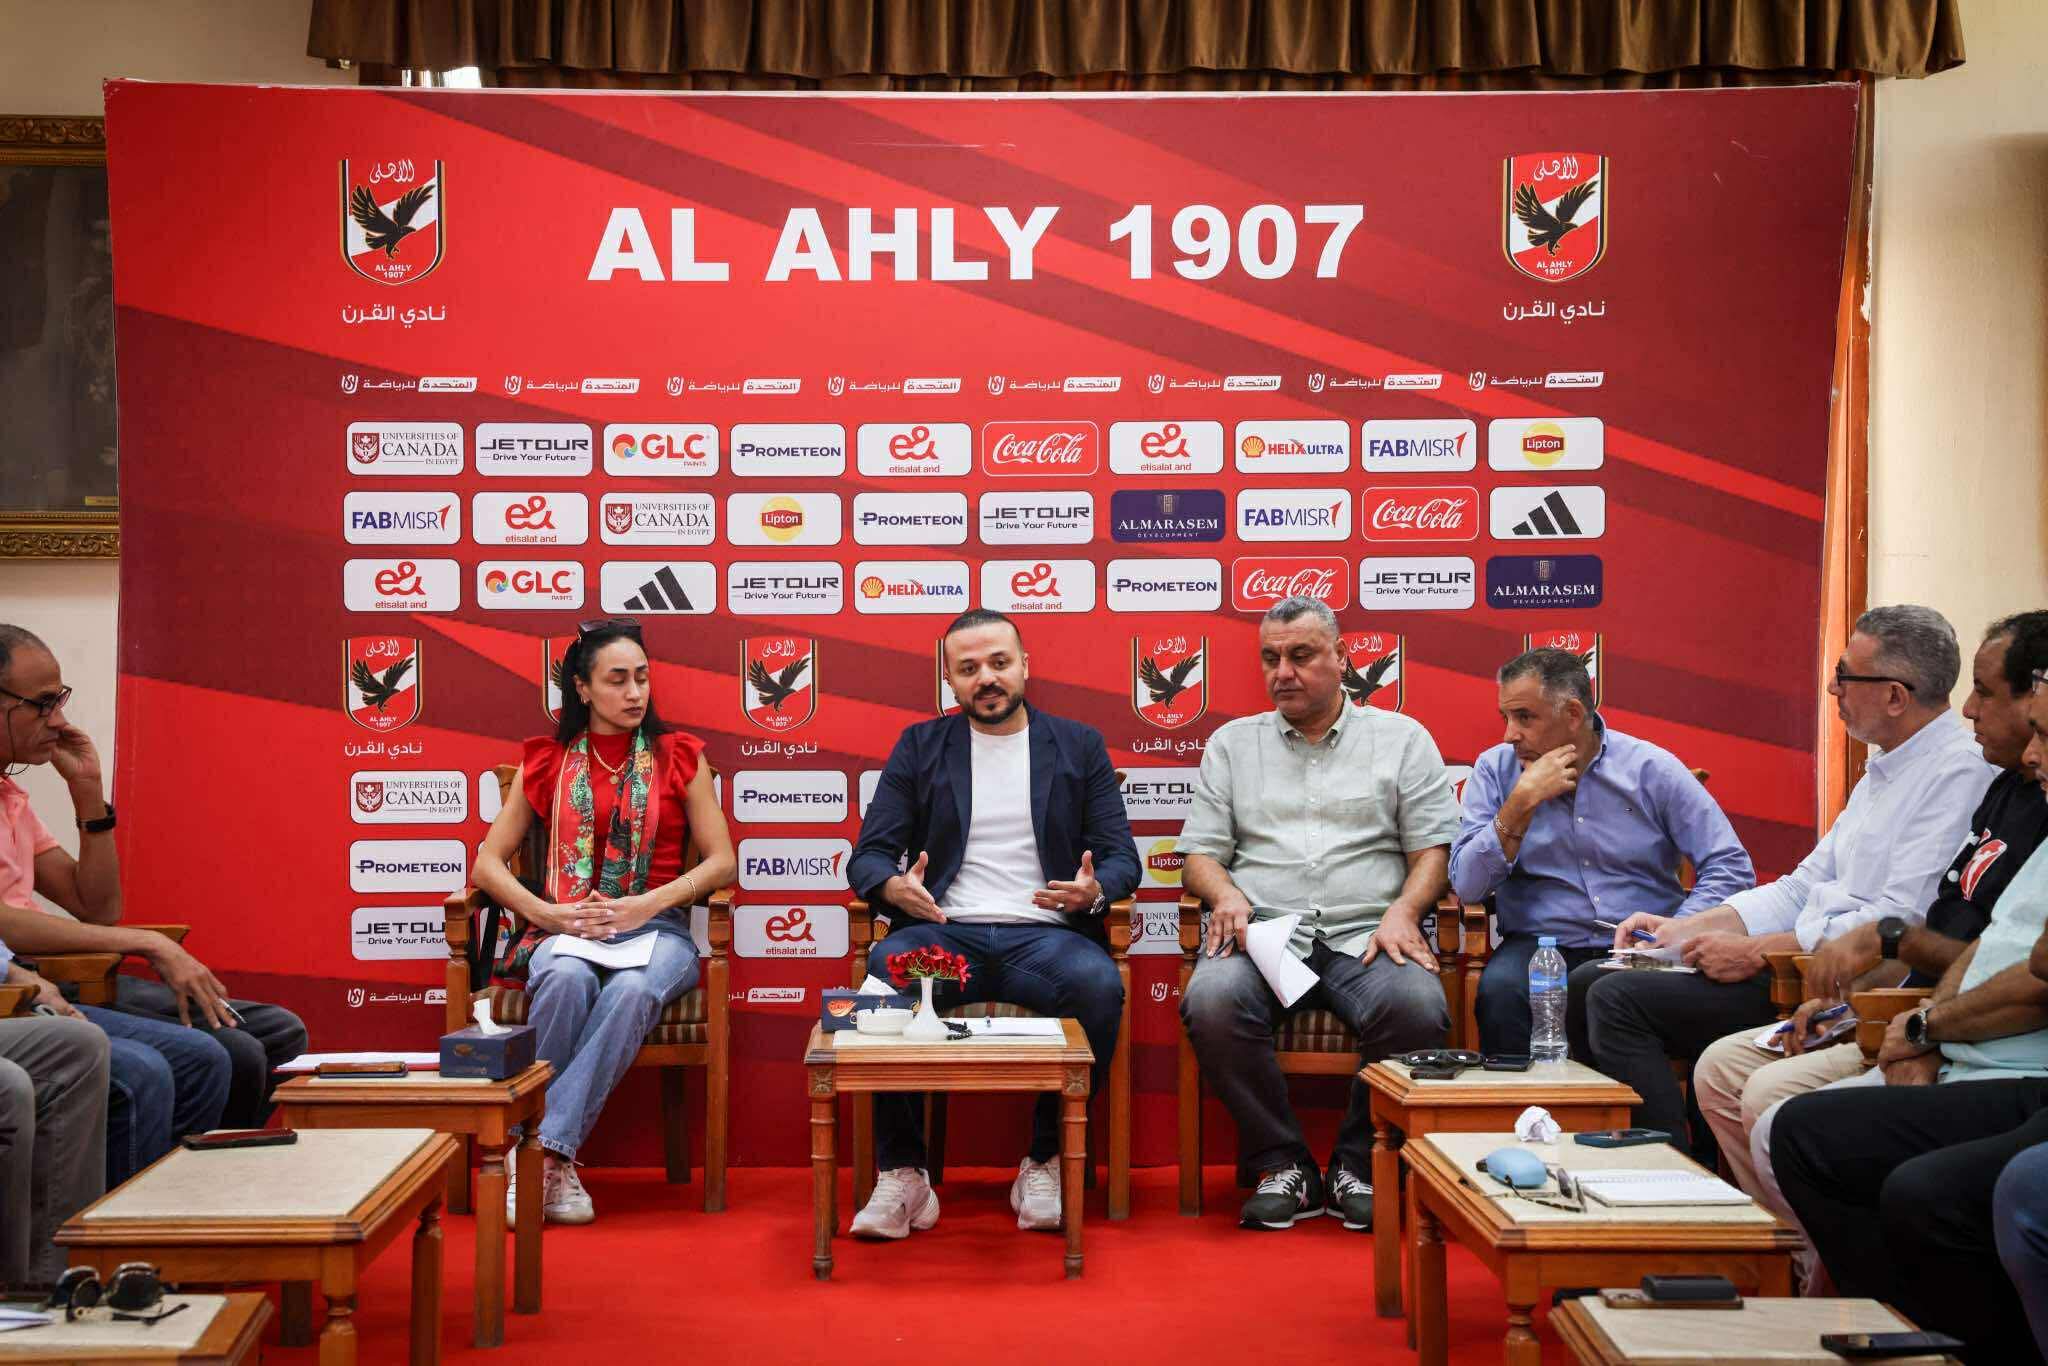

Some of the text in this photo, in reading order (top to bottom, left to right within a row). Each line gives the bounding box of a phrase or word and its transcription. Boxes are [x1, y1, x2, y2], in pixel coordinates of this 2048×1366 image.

[588, 204, 1364, 281] AL AHLY 1907
[342, 304, 446, 328] نادي القرن
[1503, 301, 1605, 324] نادي القرن
[363, 379, 415, 390] للرياضة
[527, 381, 579, 391] للرياضة
[688, 382, 740, 391] للرياضة
[850, 381, 901, 392] للرياضة
[1009, 380, 1060, 390] للرياضة
[1170, 380, 1221, 389] للرياضة
[1329, 378, 1381, 387] للرياضة
[1491, 377, 1542, 386] للرياضة
[382, 443, 458, 456] CANADA
[481, 439, 588, 450] JETOUR
[641, 434, 706, 459] GLC
[992, 433, 1087, 464] Coca-Cola
[1527, 439, 1560, 449] Lipton
[741, 443, 840, 457] PROMETEON
[1308, 445, 1343, 455] ULTRA
[889, 465, 922, 473] etisalat
[1141, 463, 1172, 471] etisalat
[984, 507, 1089, 518] JETOUR
[1373, 498, 1467, 529] Coca-Cola
[634, 513, 709, 527] CANADA
[765, 515, 798, 525] Lipton
[863, 512, 963, 525] PROMETEON
[1118, 519, 1218, 530] ALMARASEM
[505, 535, 556, 543] etisalat and
[512, 571, 572, 593] GLC
[732, 578, 838, 588] JETOUR
[1364, 573, 1470, 584] JETOUR
[927, 585, 963, 595] ULTRA
[1117, 579, 1216, 592] PROMETEON
[1243, 569, 1337, 600] Coca-Cola
[1494, 585, 1594, 596] ALMARASEM
[375, 601, 407, 609] etisalat
[1011, 602, 1042, 610] etisalat
[345, 742, 422, 759] نادي القرن
[742, 742, 817, 759] نادي القرن
[1133, 738, 1171, 752] القرن
[386, 781, 462, 789] UNIVERSITIES OF
[386, 791, 461, 804] CANADA
[743, 790, 843, 803] PROMETEON
[360, 860, 461, 873] PROMETEON
[356, 922, 445, 934] JETOU
[421, 936, 447, 944] Futur
[765, 947, 797, 955] etisalat
